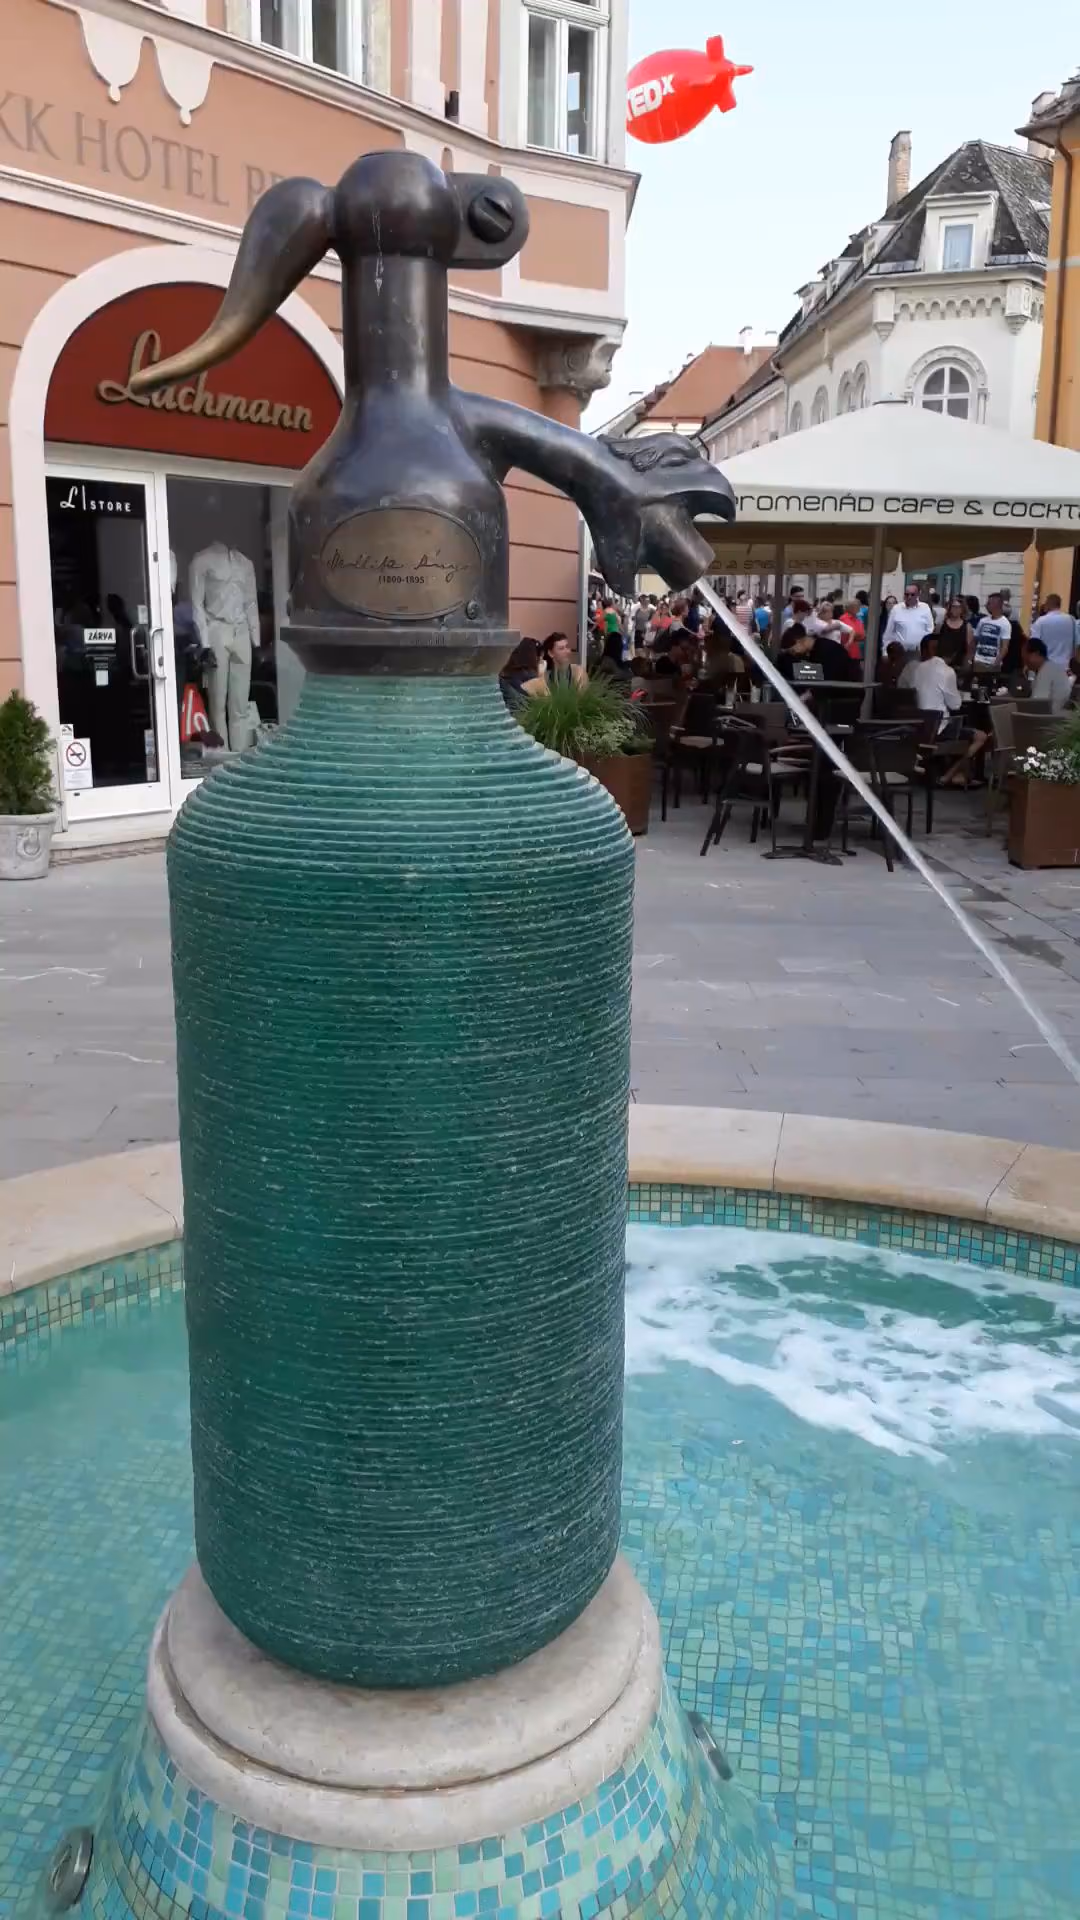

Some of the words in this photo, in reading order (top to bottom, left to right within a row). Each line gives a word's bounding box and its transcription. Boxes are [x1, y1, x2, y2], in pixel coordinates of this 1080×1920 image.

[75, 111, 230, 208] HOTEL
[97, 329, 313, 431] Lachmann
[90, 500, 131, 513] STORE
[963, 500, 984, 515] &
[88, 630, 113, 641] ZÁRVA
